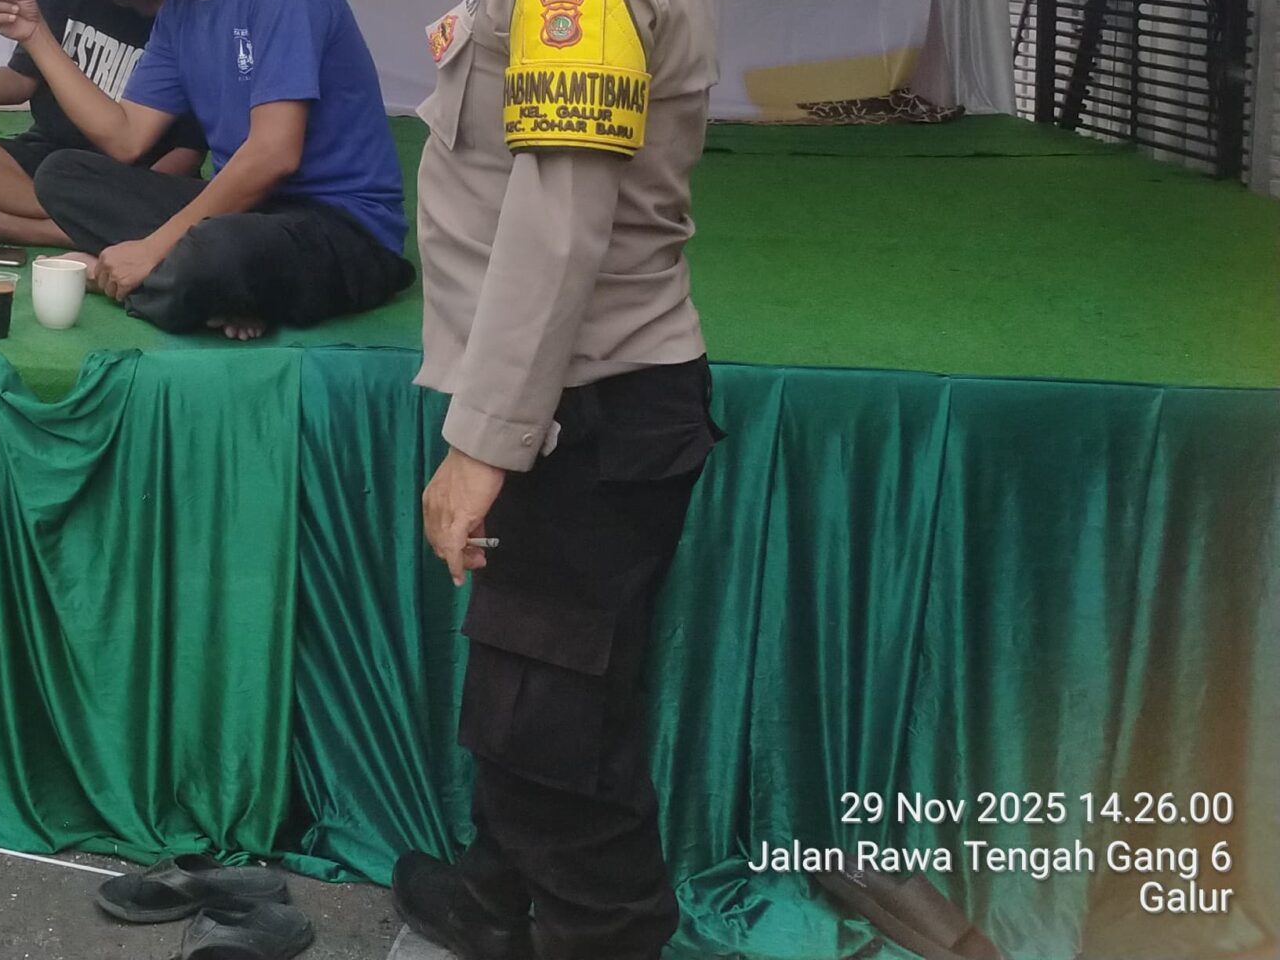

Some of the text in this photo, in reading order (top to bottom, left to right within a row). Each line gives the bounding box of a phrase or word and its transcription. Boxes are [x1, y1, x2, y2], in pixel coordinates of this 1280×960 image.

[520, 105, 613, 122] KEL. GALUR
[530, 119, 588, 134] JOHAR
[595, 121, 634, 140] BARU
